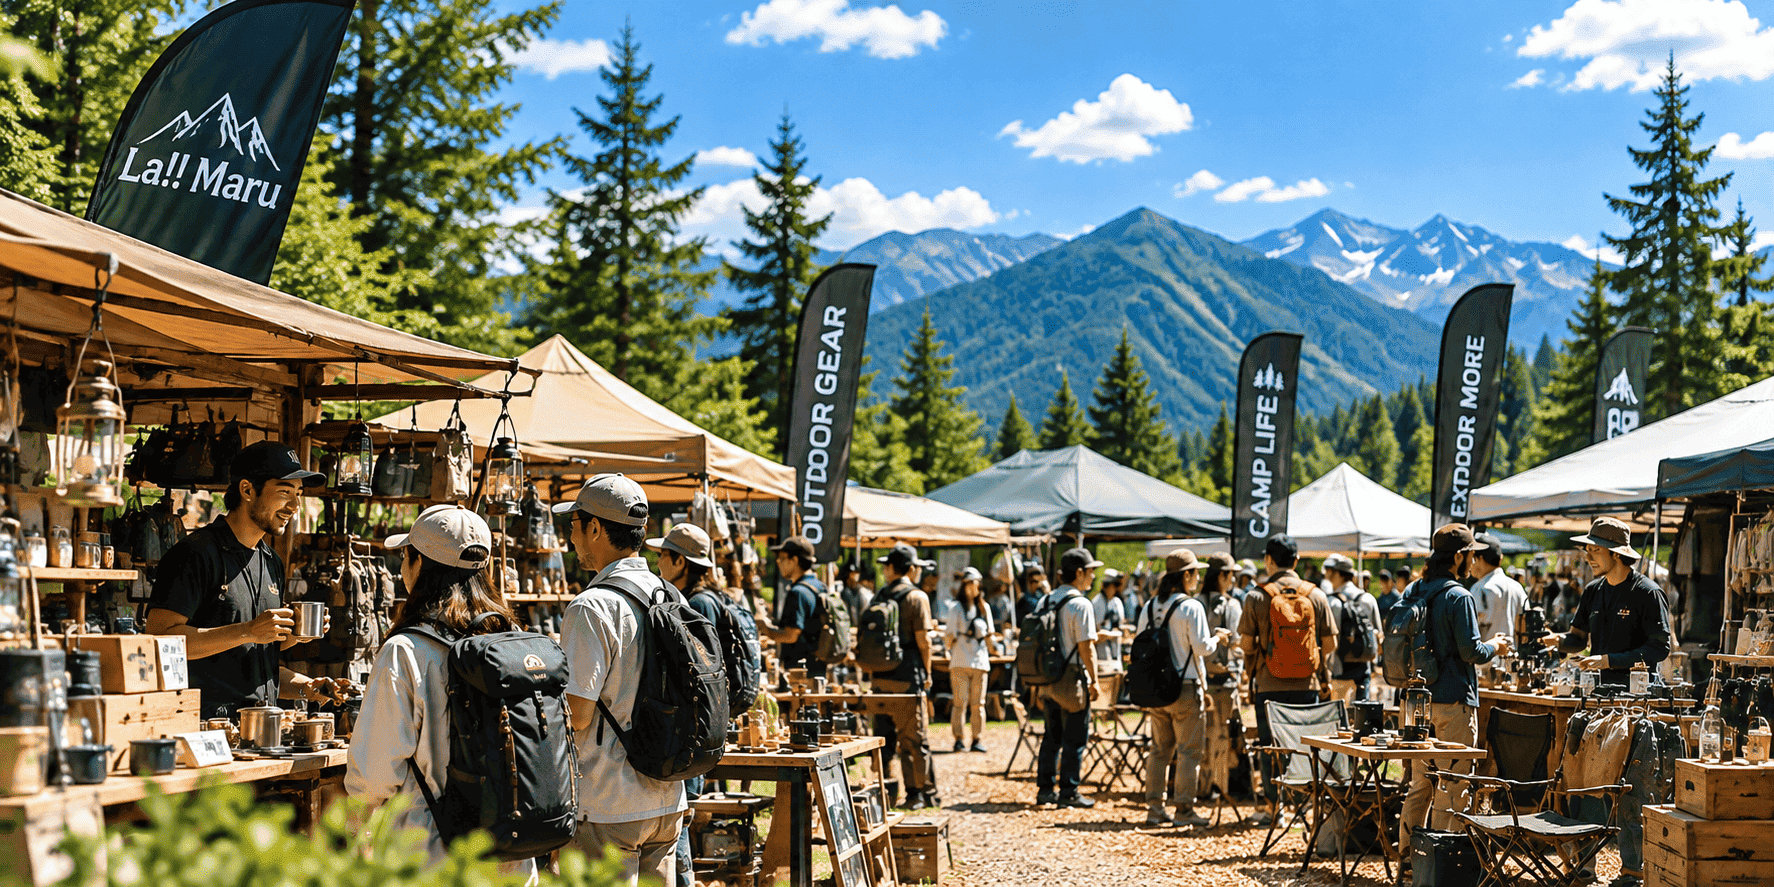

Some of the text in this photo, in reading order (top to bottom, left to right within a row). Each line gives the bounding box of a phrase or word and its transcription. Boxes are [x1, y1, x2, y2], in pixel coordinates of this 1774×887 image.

[117, 146, 282, 210] La!! Maru
[801, 305, 847, 545] OUTDOOR GEAR
[1460, 334, 1485, 409] MORE
[1249, 395, 1279, 538] CAMP LIFE
